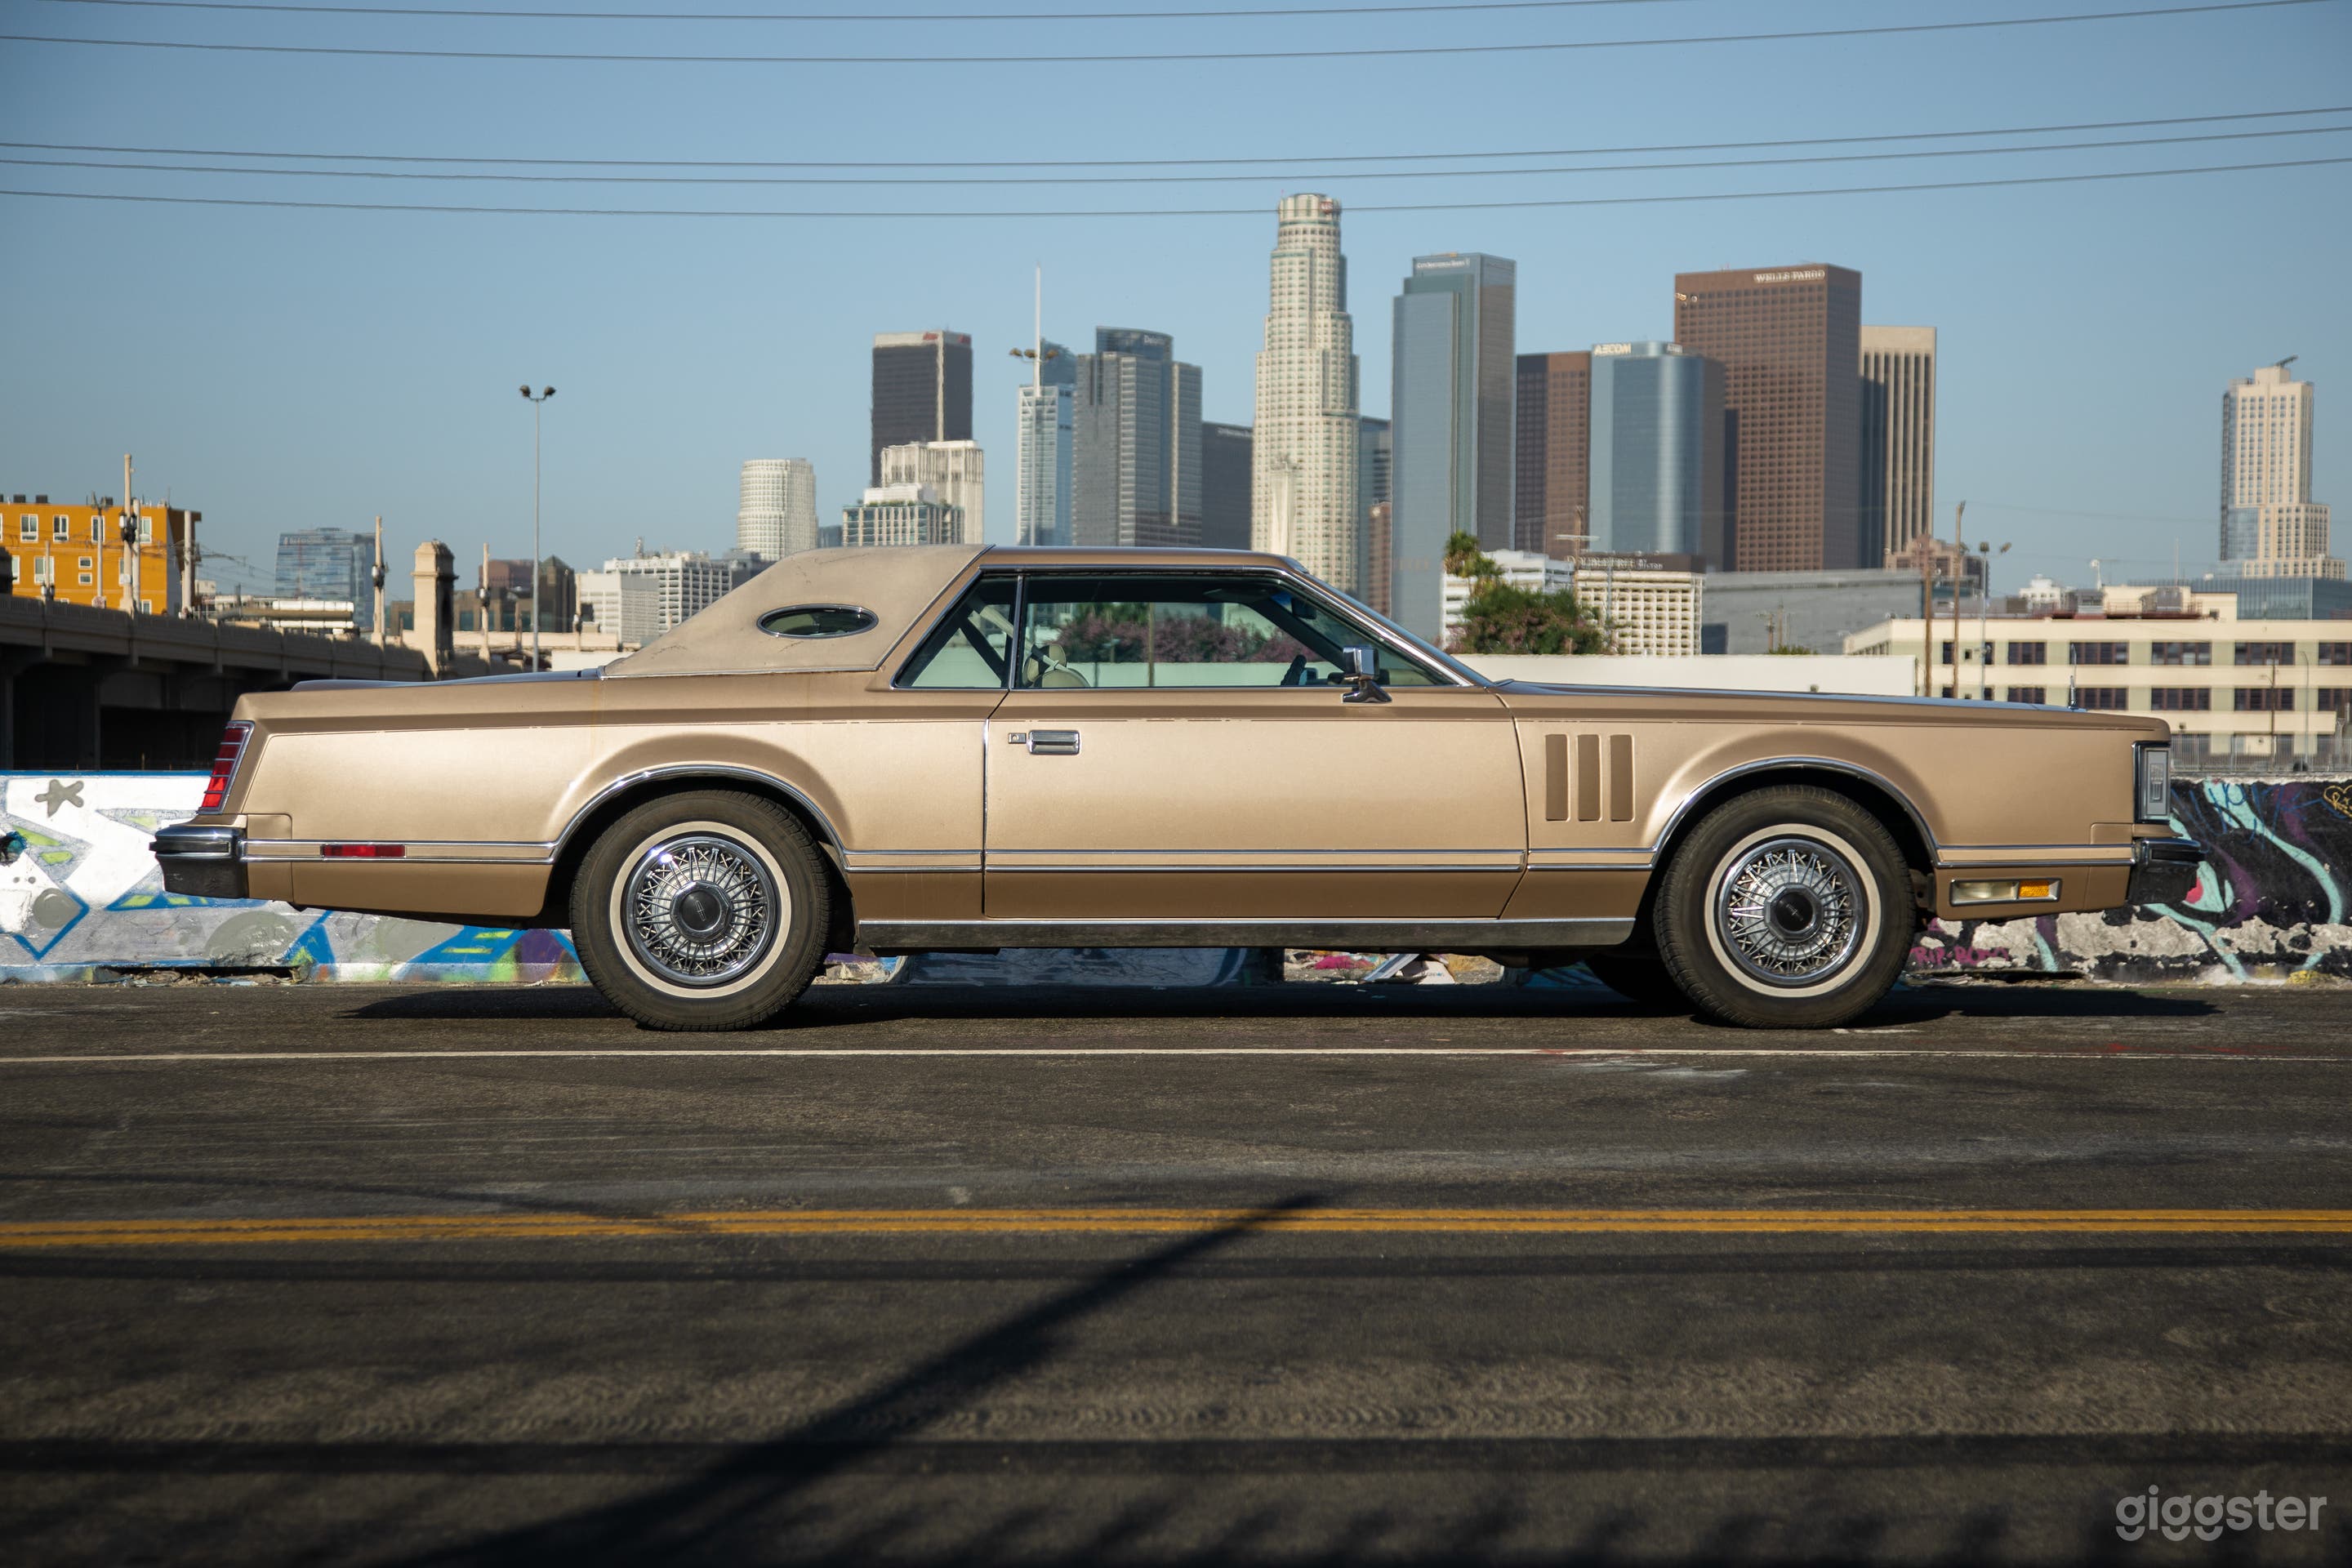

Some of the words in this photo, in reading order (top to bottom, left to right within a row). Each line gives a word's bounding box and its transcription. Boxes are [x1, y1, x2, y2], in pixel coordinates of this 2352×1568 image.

[1753, 271, 1791, 283] WELLS
[1792, 270, 1825, 281] FARGO
[1593, 343, 1632, 355] AECOM
